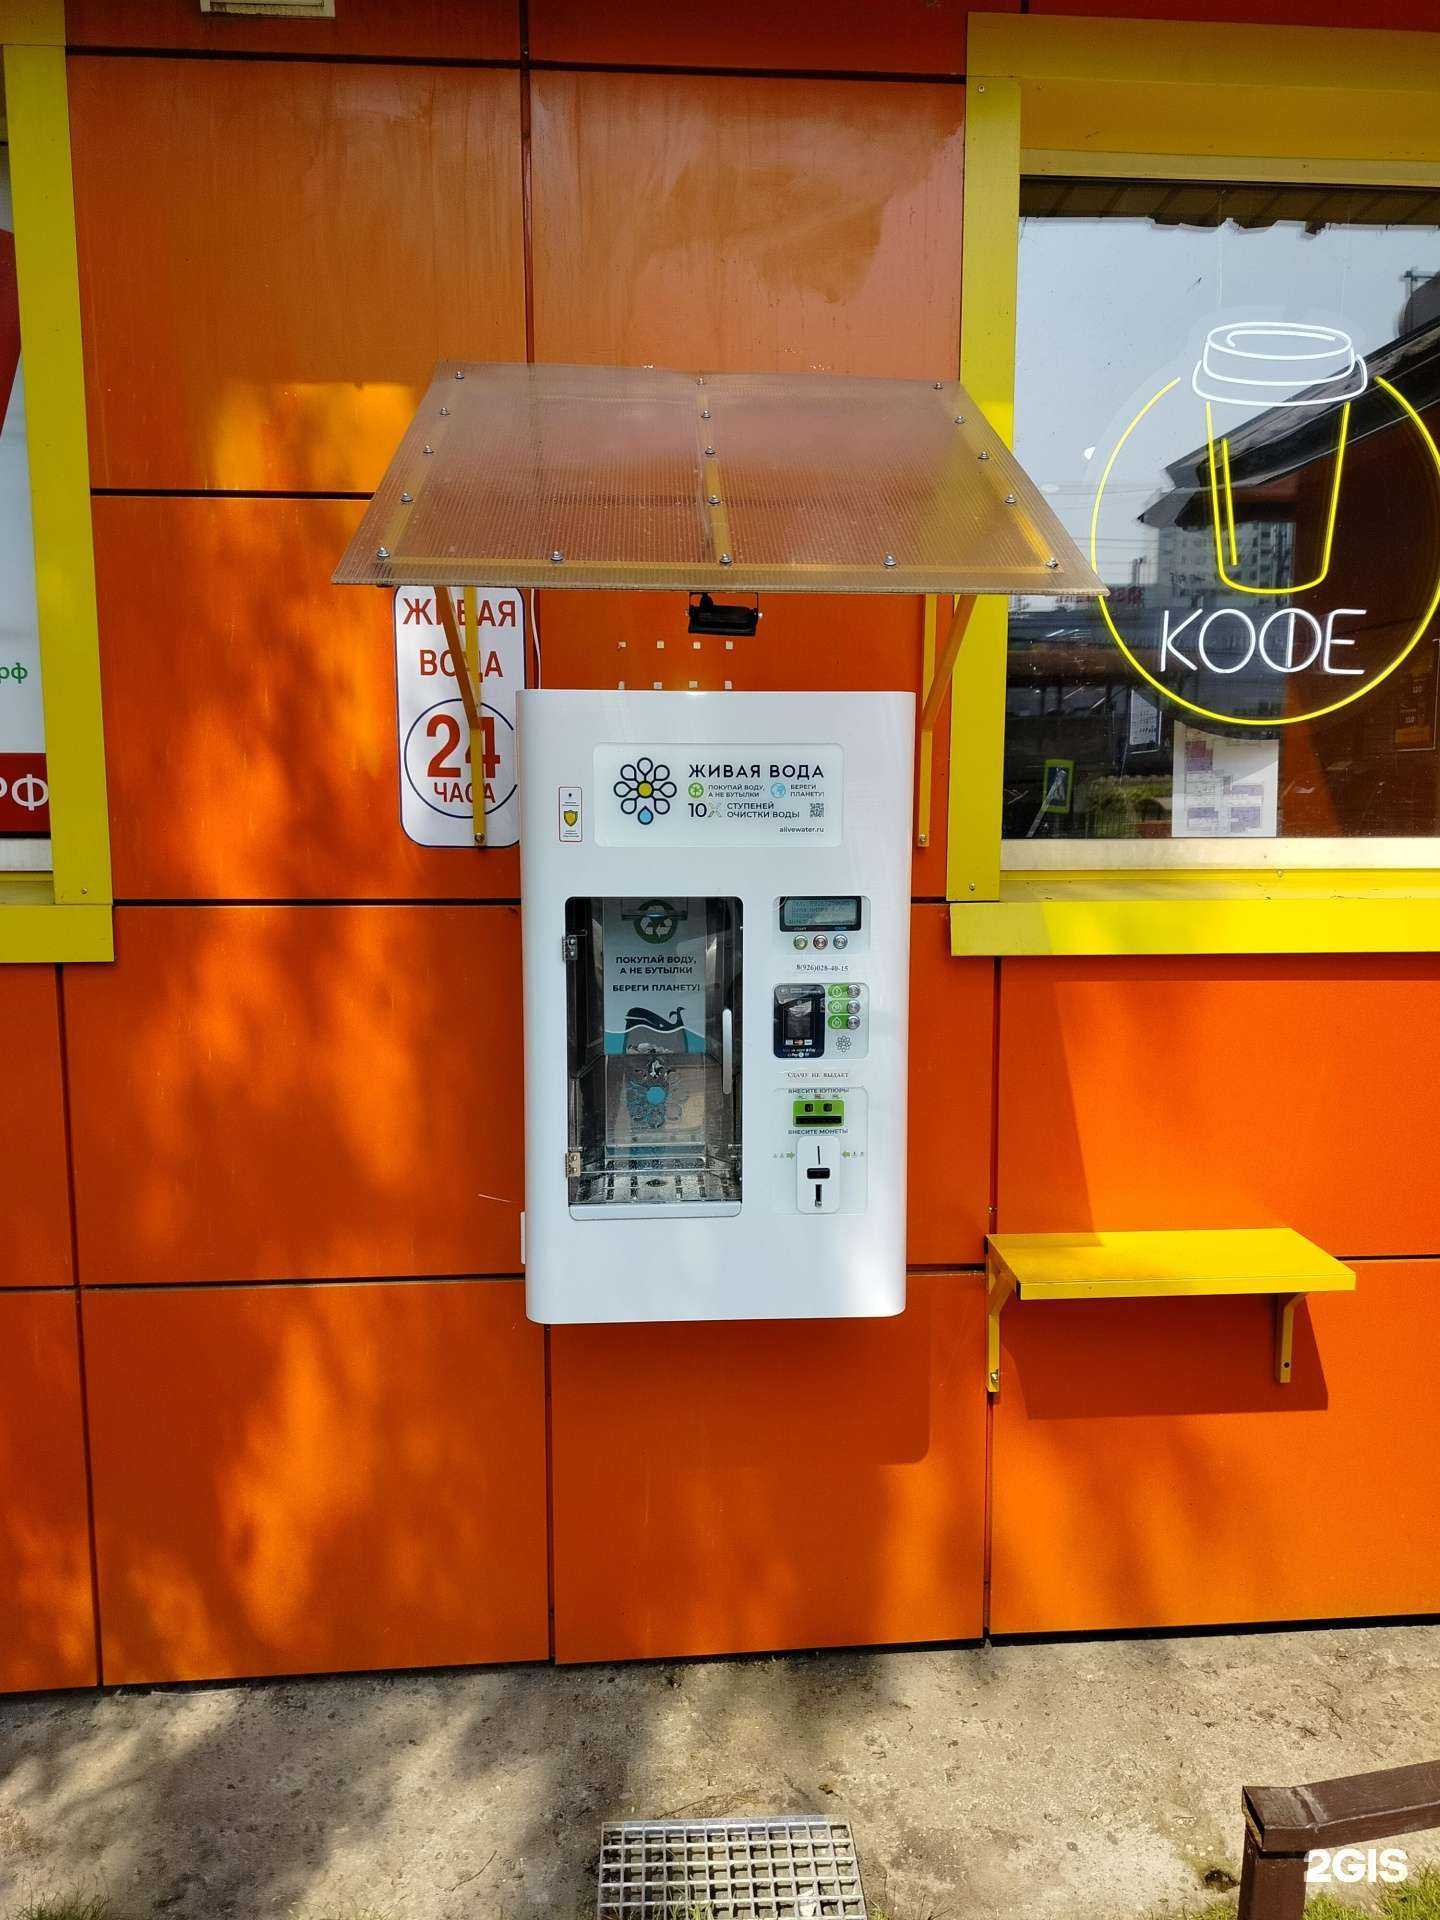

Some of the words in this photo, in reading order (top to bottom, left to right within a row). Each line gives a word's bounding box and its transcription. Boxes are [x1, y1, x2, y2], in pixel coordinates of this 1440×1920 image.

[1160, 608, 1367, 675] КОФЕ
[420, 649, 504, 682] ВОА
[426, 713, 501, 778] 24
[689, 764, 761, 779] ЖИВАЯ
[769, 764, 825, 780] ВОДА
[688, 803, 707, 818] 10
[726, 801, 774, 810] СТУПЕНЕЙ
[772, 811, 800, 819] ВОДЫ
[616, 955, 664, 964] ПОКУПАЙ
[667, 956, 697, 965] ВОДУ,
[612, 984, 649, 992] БЕРЕГИ
[652, 984, 700, 992] ПЛАНЕТУ!
